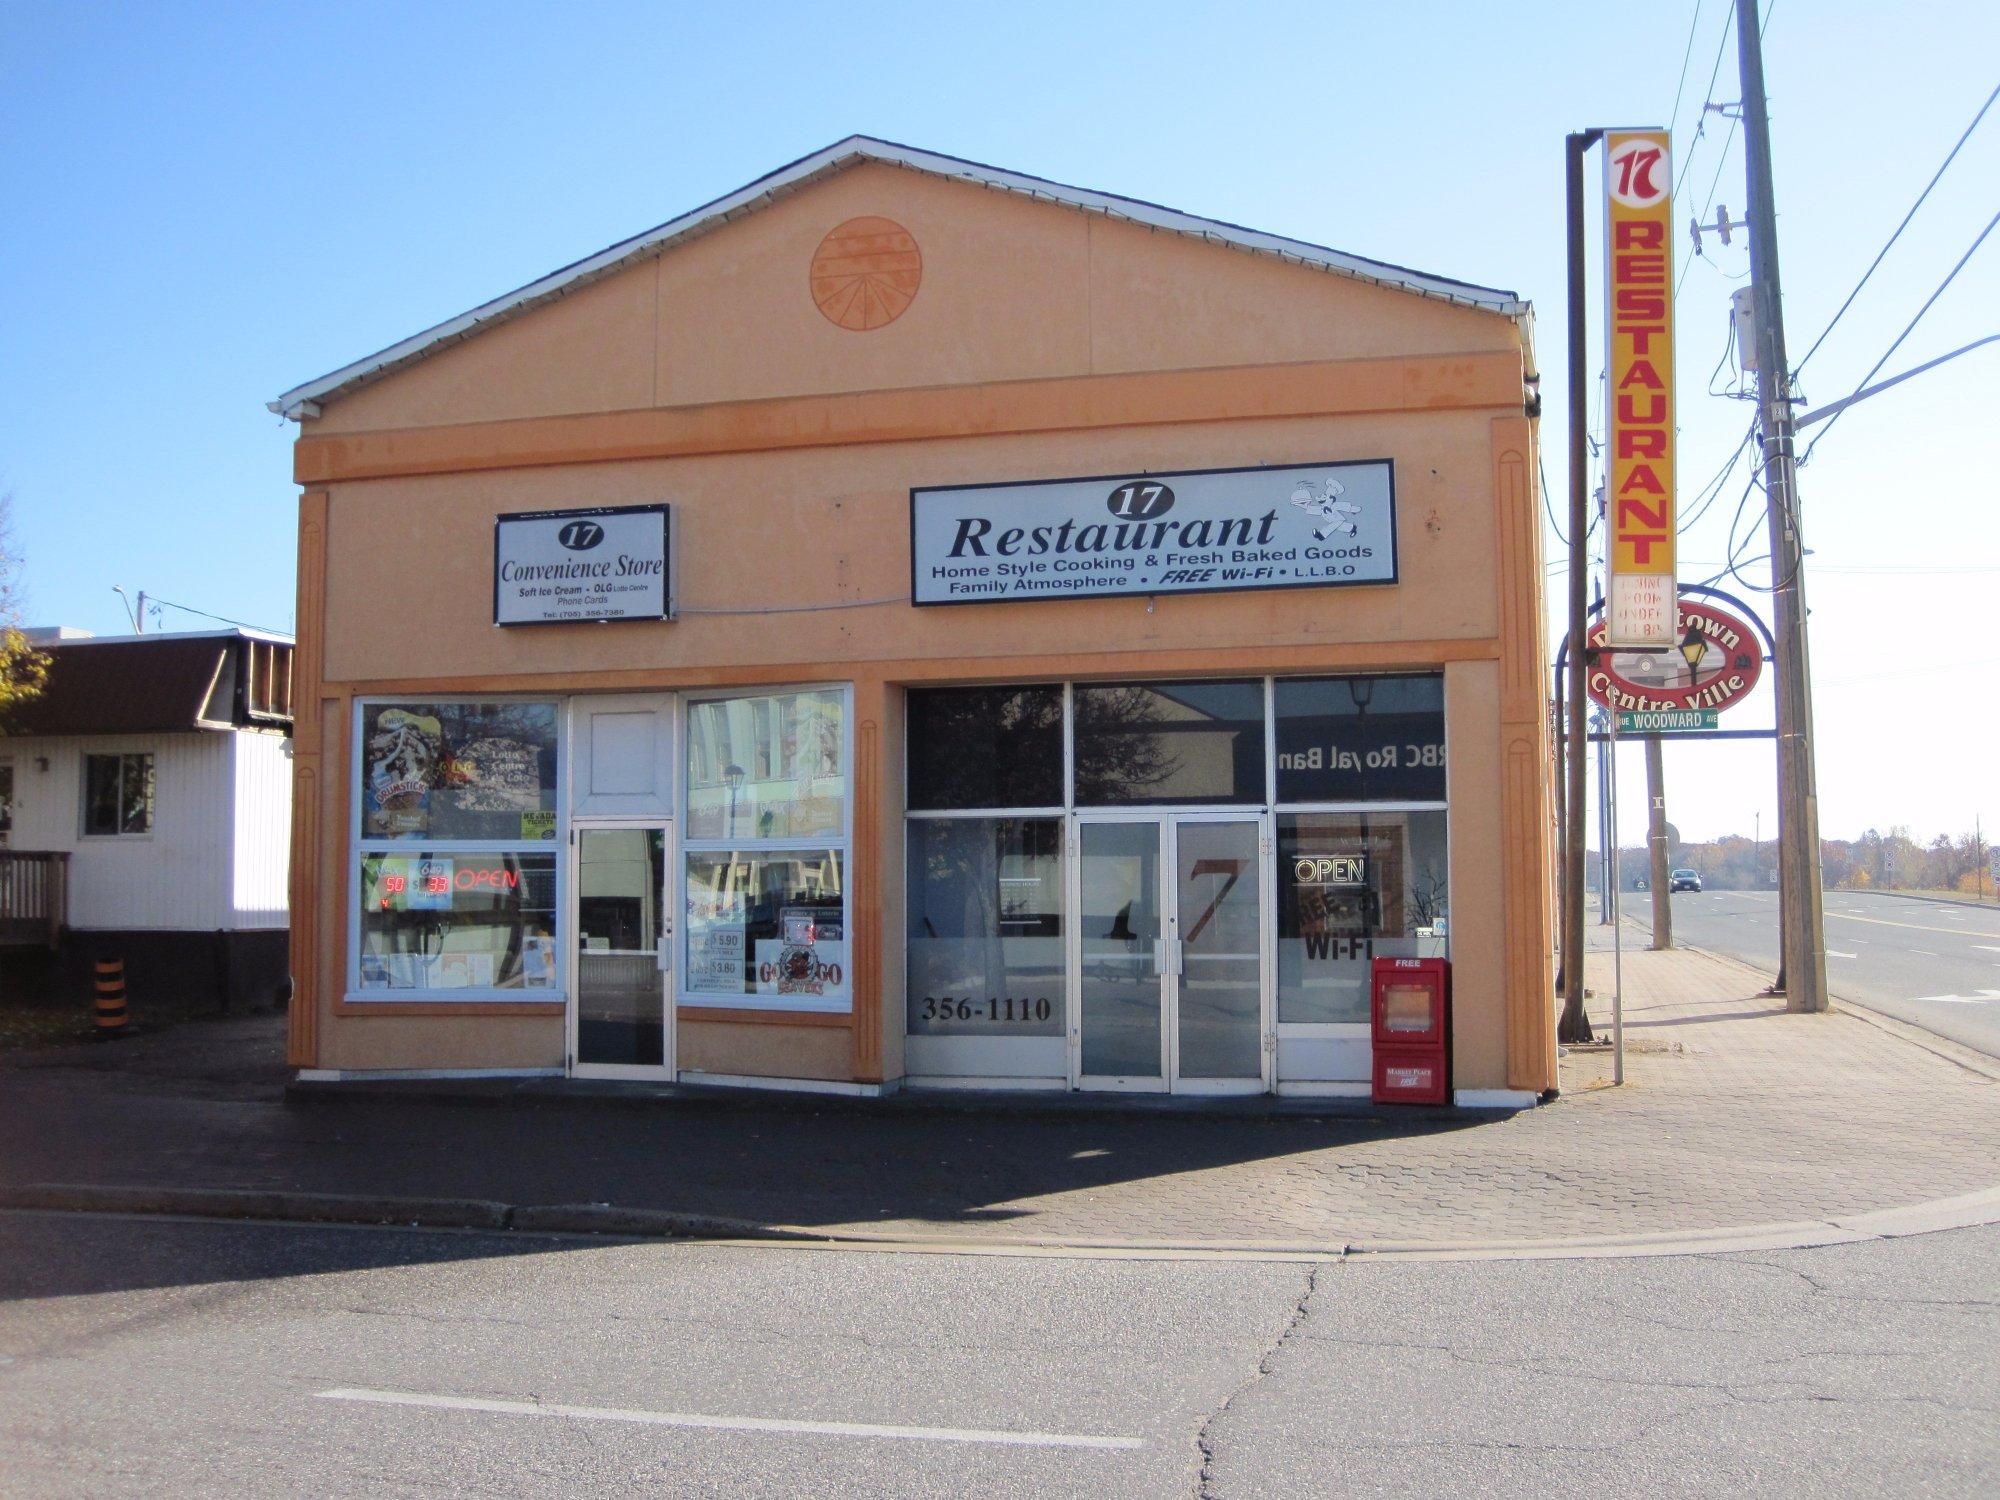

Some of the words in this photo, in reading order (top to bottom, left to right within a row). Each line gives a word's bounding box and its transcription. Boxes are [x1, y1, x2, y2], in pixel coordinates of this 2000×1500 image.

[1614, 147, 1661, 199] 17
[1615, 220, 1666, 564] RESTAURANT
[1116, 486, 1163, 516] 17
[565, 526, 598, 546] 17
[946, 508, 1279, 558] Restaurant
[502, 557, 611, 582] Convenience
[615, 554, 662, 576] Store
[932, 565, 990, 579] Home
[996, 560, 1047, 577] Style
[1053, 556, 1136, 573] Cooking
[1145, 554, 1158, 566] &
[1166, 552, 1223, 565] Fresh
[1232, 548, 1297, 563] Baked
[1304, 545, 1373, 560] Goods
[519, 586, 537, 598] Soft
[539, 586, 551, 596] Ice
[554, 584, 582, 595] Cream
[594, 583, 612, 593] OLG
[629, 583, 648, 591] Centre
[950, 578, 1008, 595] Family
[1014, 574, 1127, 590] Atmosphere
[1159, 568, 1217, 584] FREE
[1221, 567, 1273, 581] Wi-Fi
[1294, 565, 1355, 577] L.L.B.O
[584, 596, 608, 605] Cards
[1591, 672, 1676, 712] Centre
[1685, 675, 1745, 711] Ville
[1619, 716, 1630, 727] UE
[1634, 713, 1702, 729] WOODWARD
[376, 780, 427, 804] DRUMSTICK
[455, 868, 519, 889] OPEN
[1295, 859, 1364, 882] OPEN
[385, 877, 405, 892] 50
[922, 998, 1051, 1021] 356-1110
